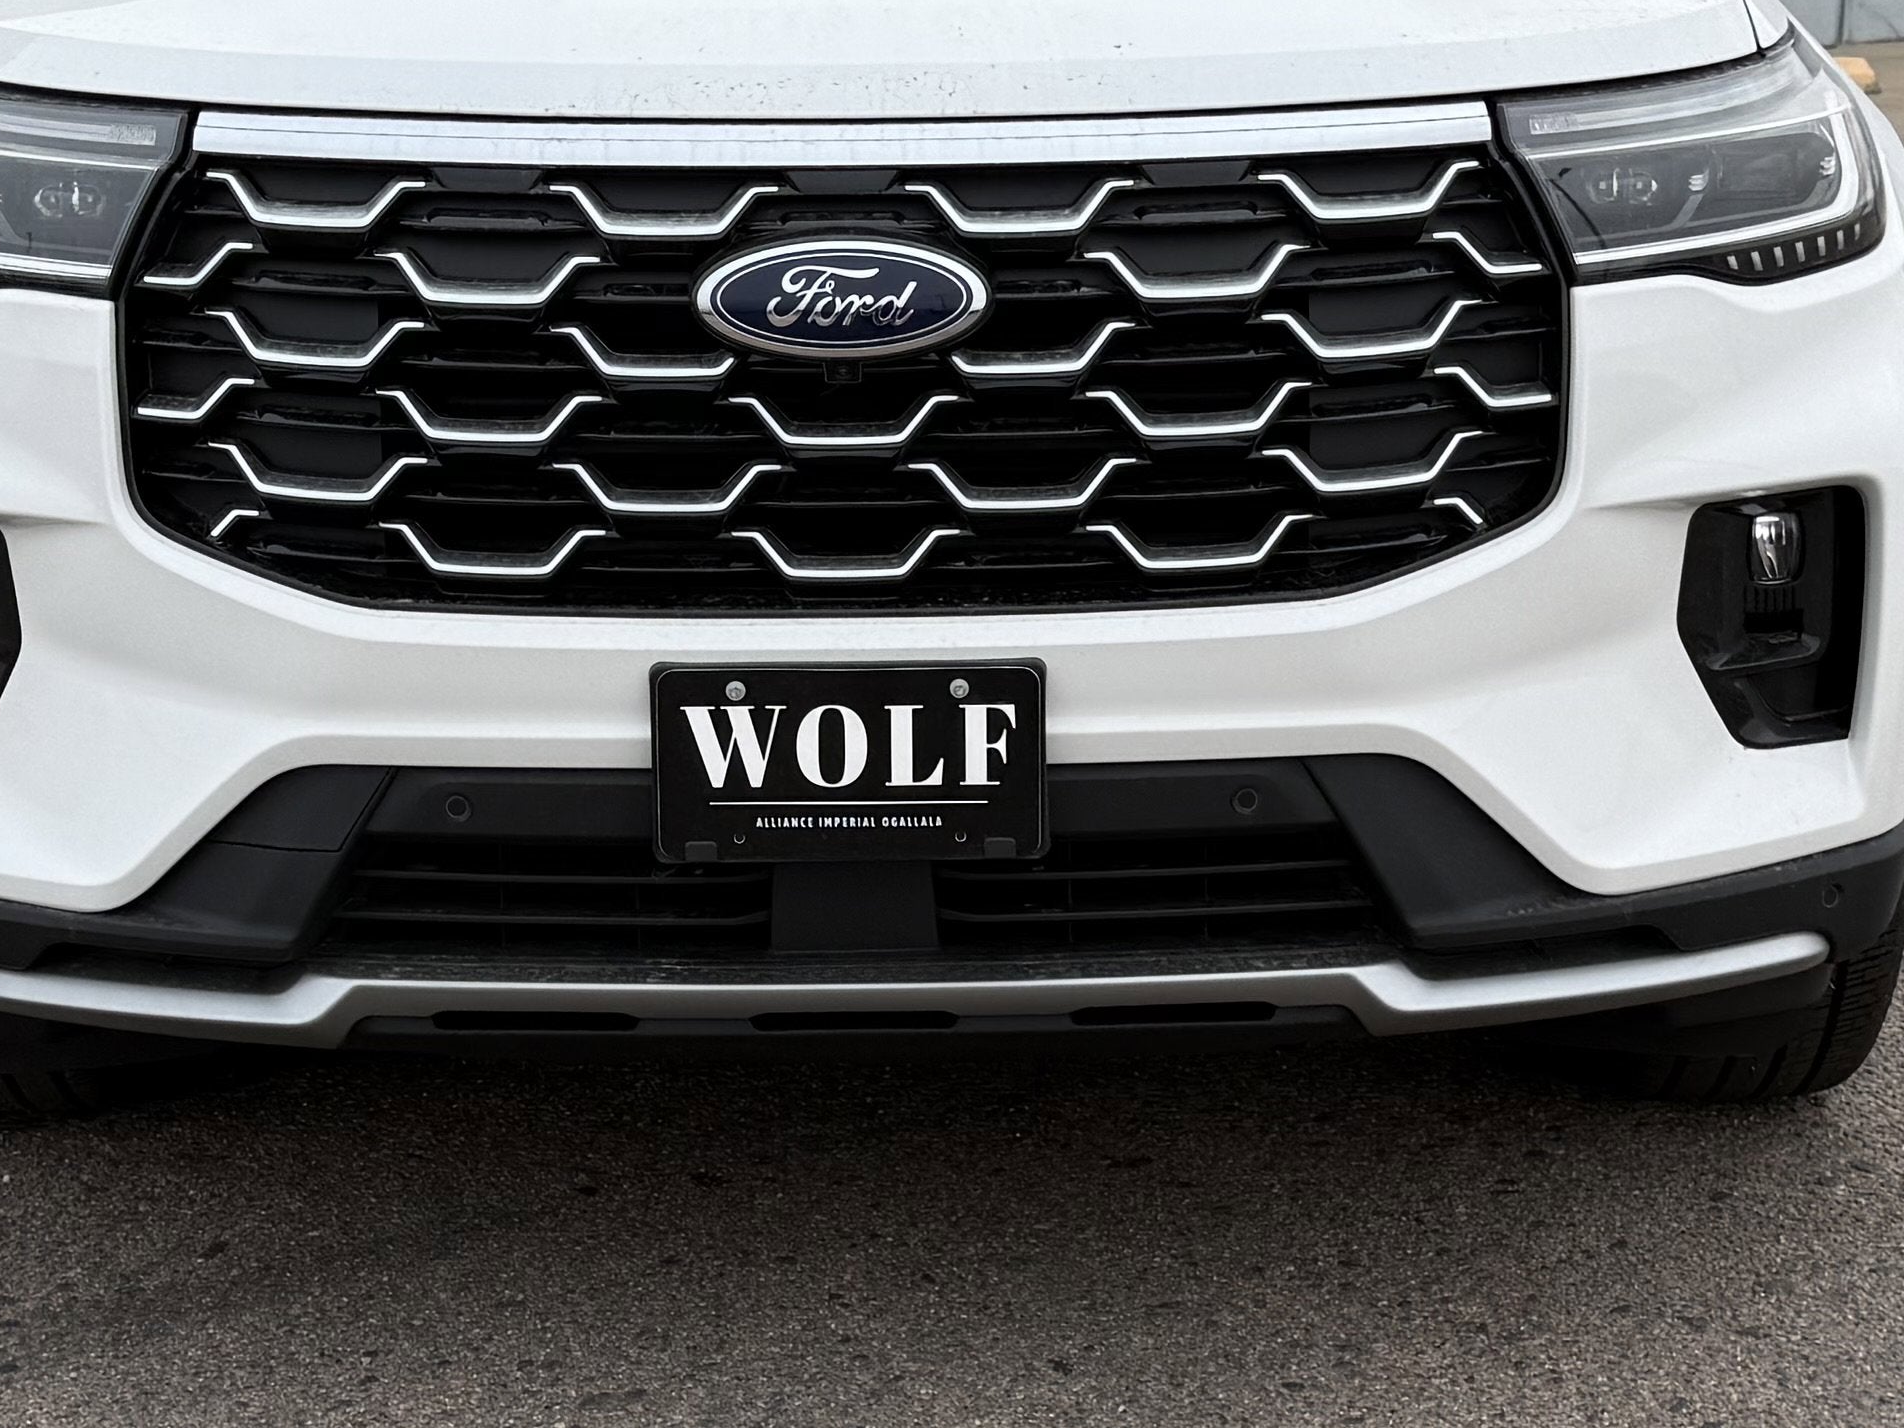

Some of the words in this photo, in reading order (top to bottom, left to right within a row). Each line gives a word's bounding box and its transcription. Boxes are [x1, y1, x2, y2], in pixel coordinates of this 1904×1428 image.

[766, 265, 918, 327] Ford
[680, 704, 1017, 788] WOLF
[756, 817, 813, 828] ALLIANCE
[818, 817, 876, 828] IMPERIAL
[881, 816, 943, 827] OGALLALA
